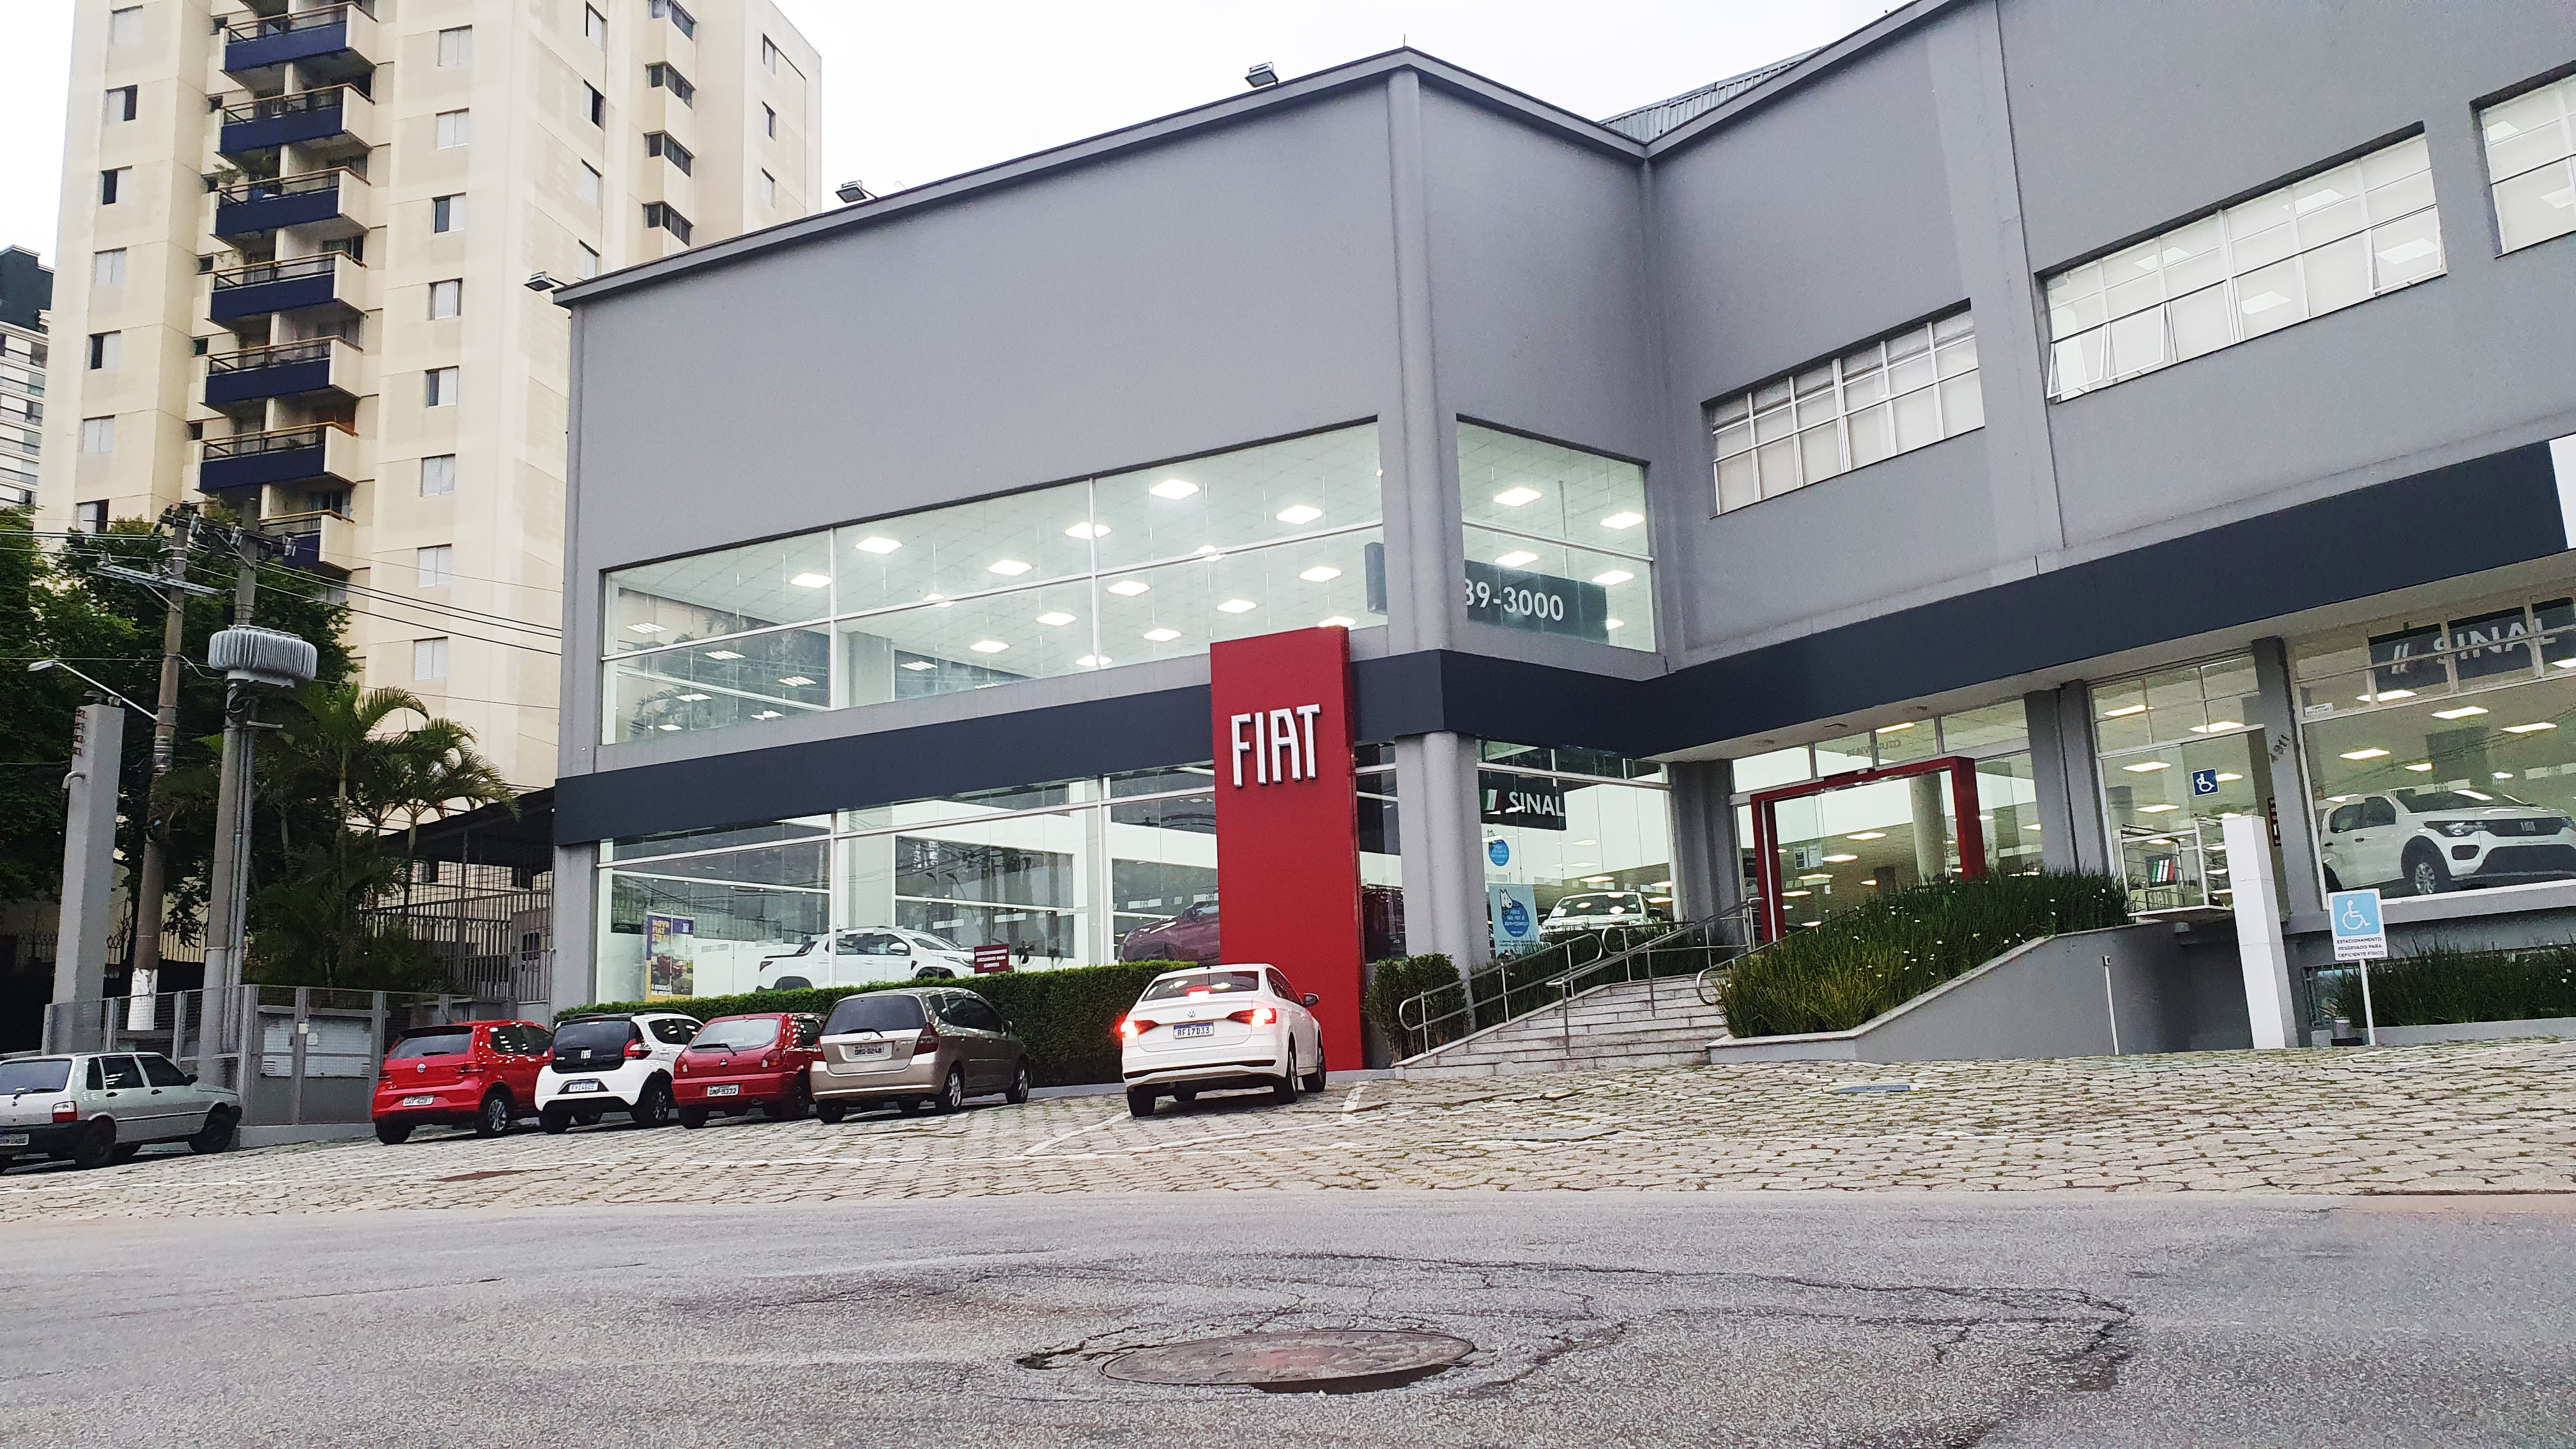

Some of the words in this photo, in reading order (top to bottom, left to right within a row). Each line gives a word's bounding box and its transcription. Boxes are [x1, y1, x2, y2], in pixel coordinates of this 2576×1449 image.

[1230, 703, 1321, 788] FIAT
[1508, 791, 1565, 816] SINAL
[580, 1049, 592, 1059] FIAT
